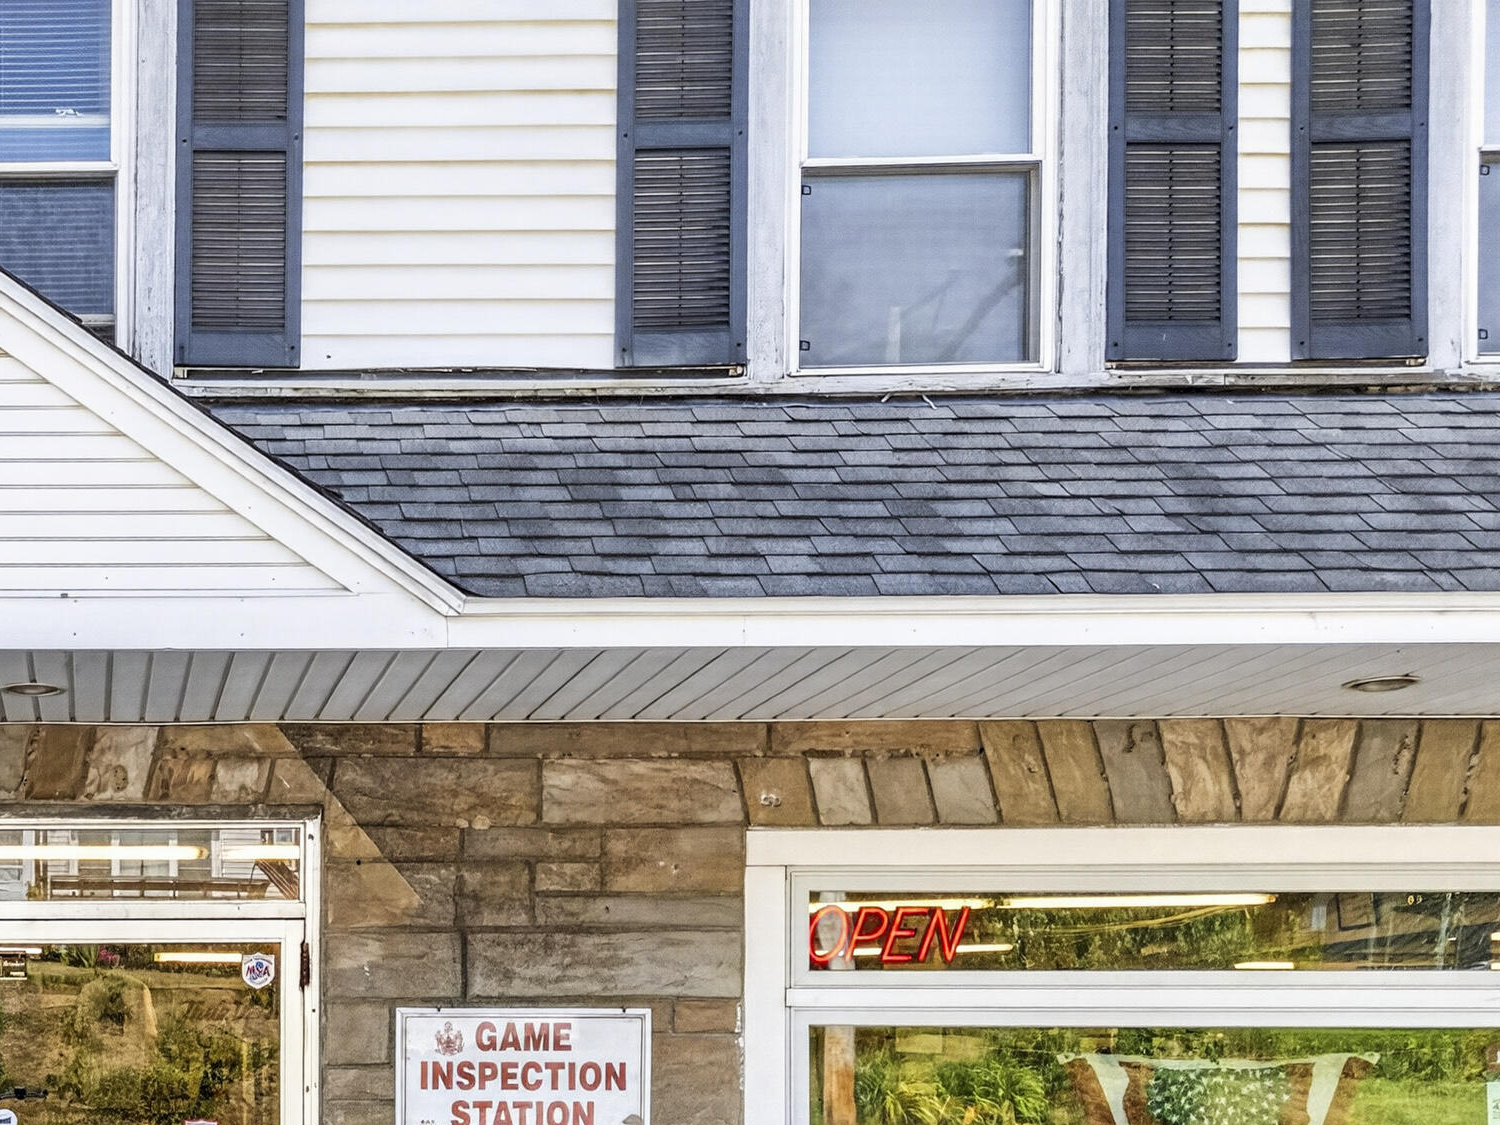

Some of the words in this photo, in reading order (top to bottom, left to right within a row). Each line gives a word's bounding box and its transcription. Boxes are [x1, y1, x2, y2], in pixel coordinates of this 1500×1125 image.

[809, 905, 971, 963] OPEN
[475, 1021, 572, 1052] GAME
[420, 1060, 627, 1092] INSPECTION
